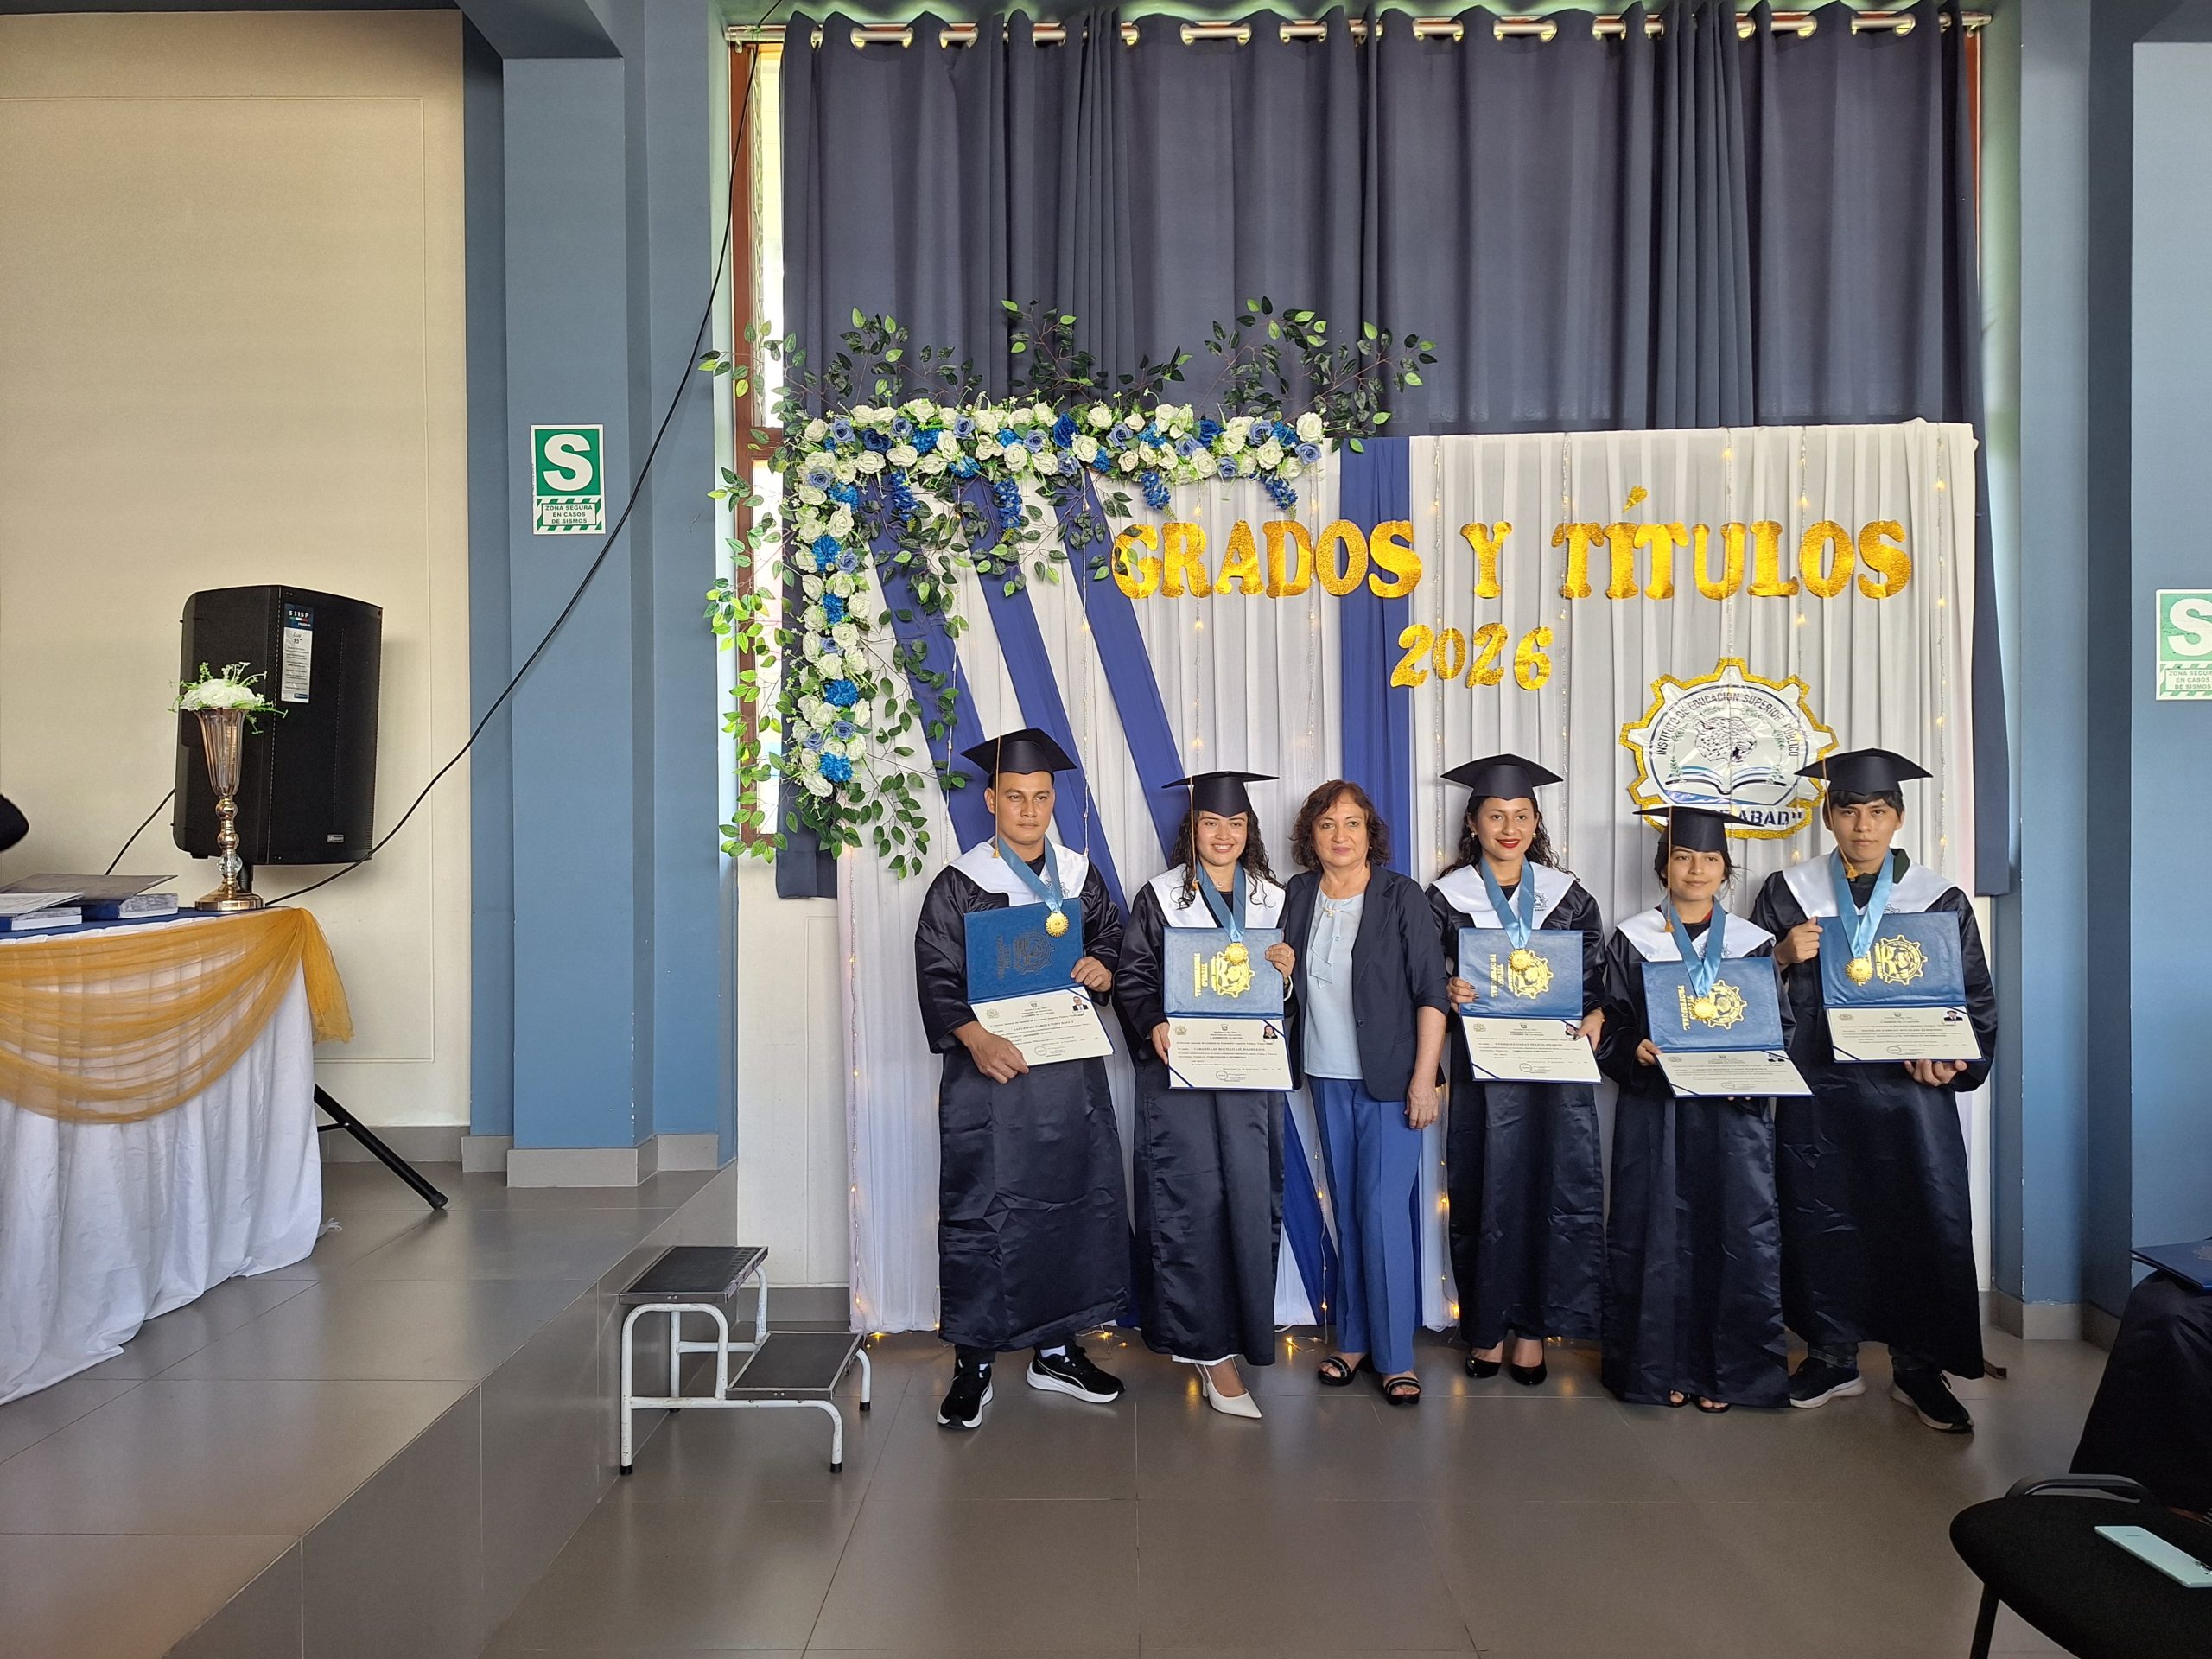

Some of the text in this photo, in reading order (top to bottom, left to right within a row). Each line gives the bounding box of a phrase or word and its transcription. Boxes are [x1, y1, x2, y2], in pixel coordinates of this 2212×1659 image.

[543, 433, 593, 491] S
[1111, 486, 1912, 600] GRADOS Y TÍTULOS
[1390, 622, 1554, 690] 2026
[2167, 598, 2212, 657] S
[1656, 717, 1681, 755] INSTITUTO
[1742, 694, 1785, 722] SUPERIOR
